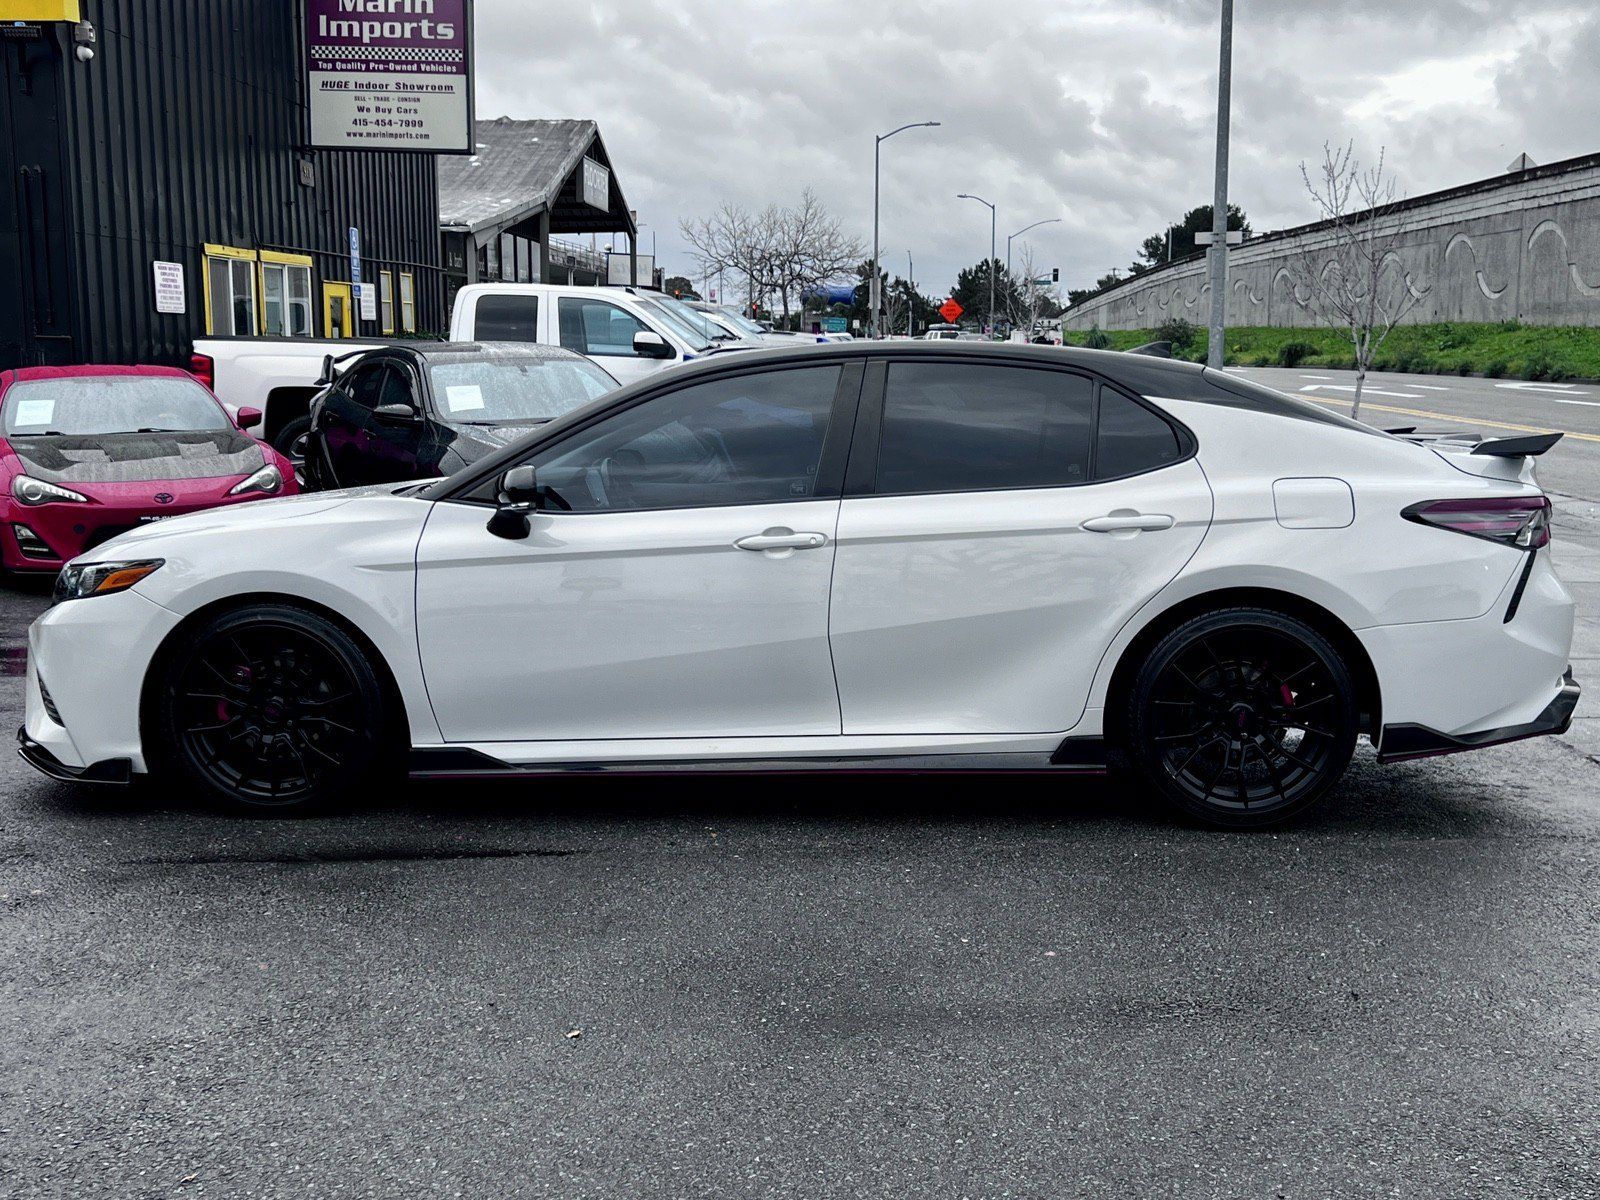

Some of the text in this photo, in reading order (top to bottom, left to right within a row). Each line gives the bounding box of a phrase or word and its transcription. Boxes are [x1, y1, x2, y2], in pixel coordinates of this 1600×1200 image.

[339, 0, 434, 14] Marin
[319, 15, 454, 43] Imports
[318, 61, 457, 73] Top Quality Pre-Owned Vehicles
[321, 80, 454, 91] HUGE Indoor Showroom
[356, 105, 418, 115] We Buy Cars
[352, 118, 424, 128] 415-454-7999
[346, 131, 430, 140] www.marinimports.com
